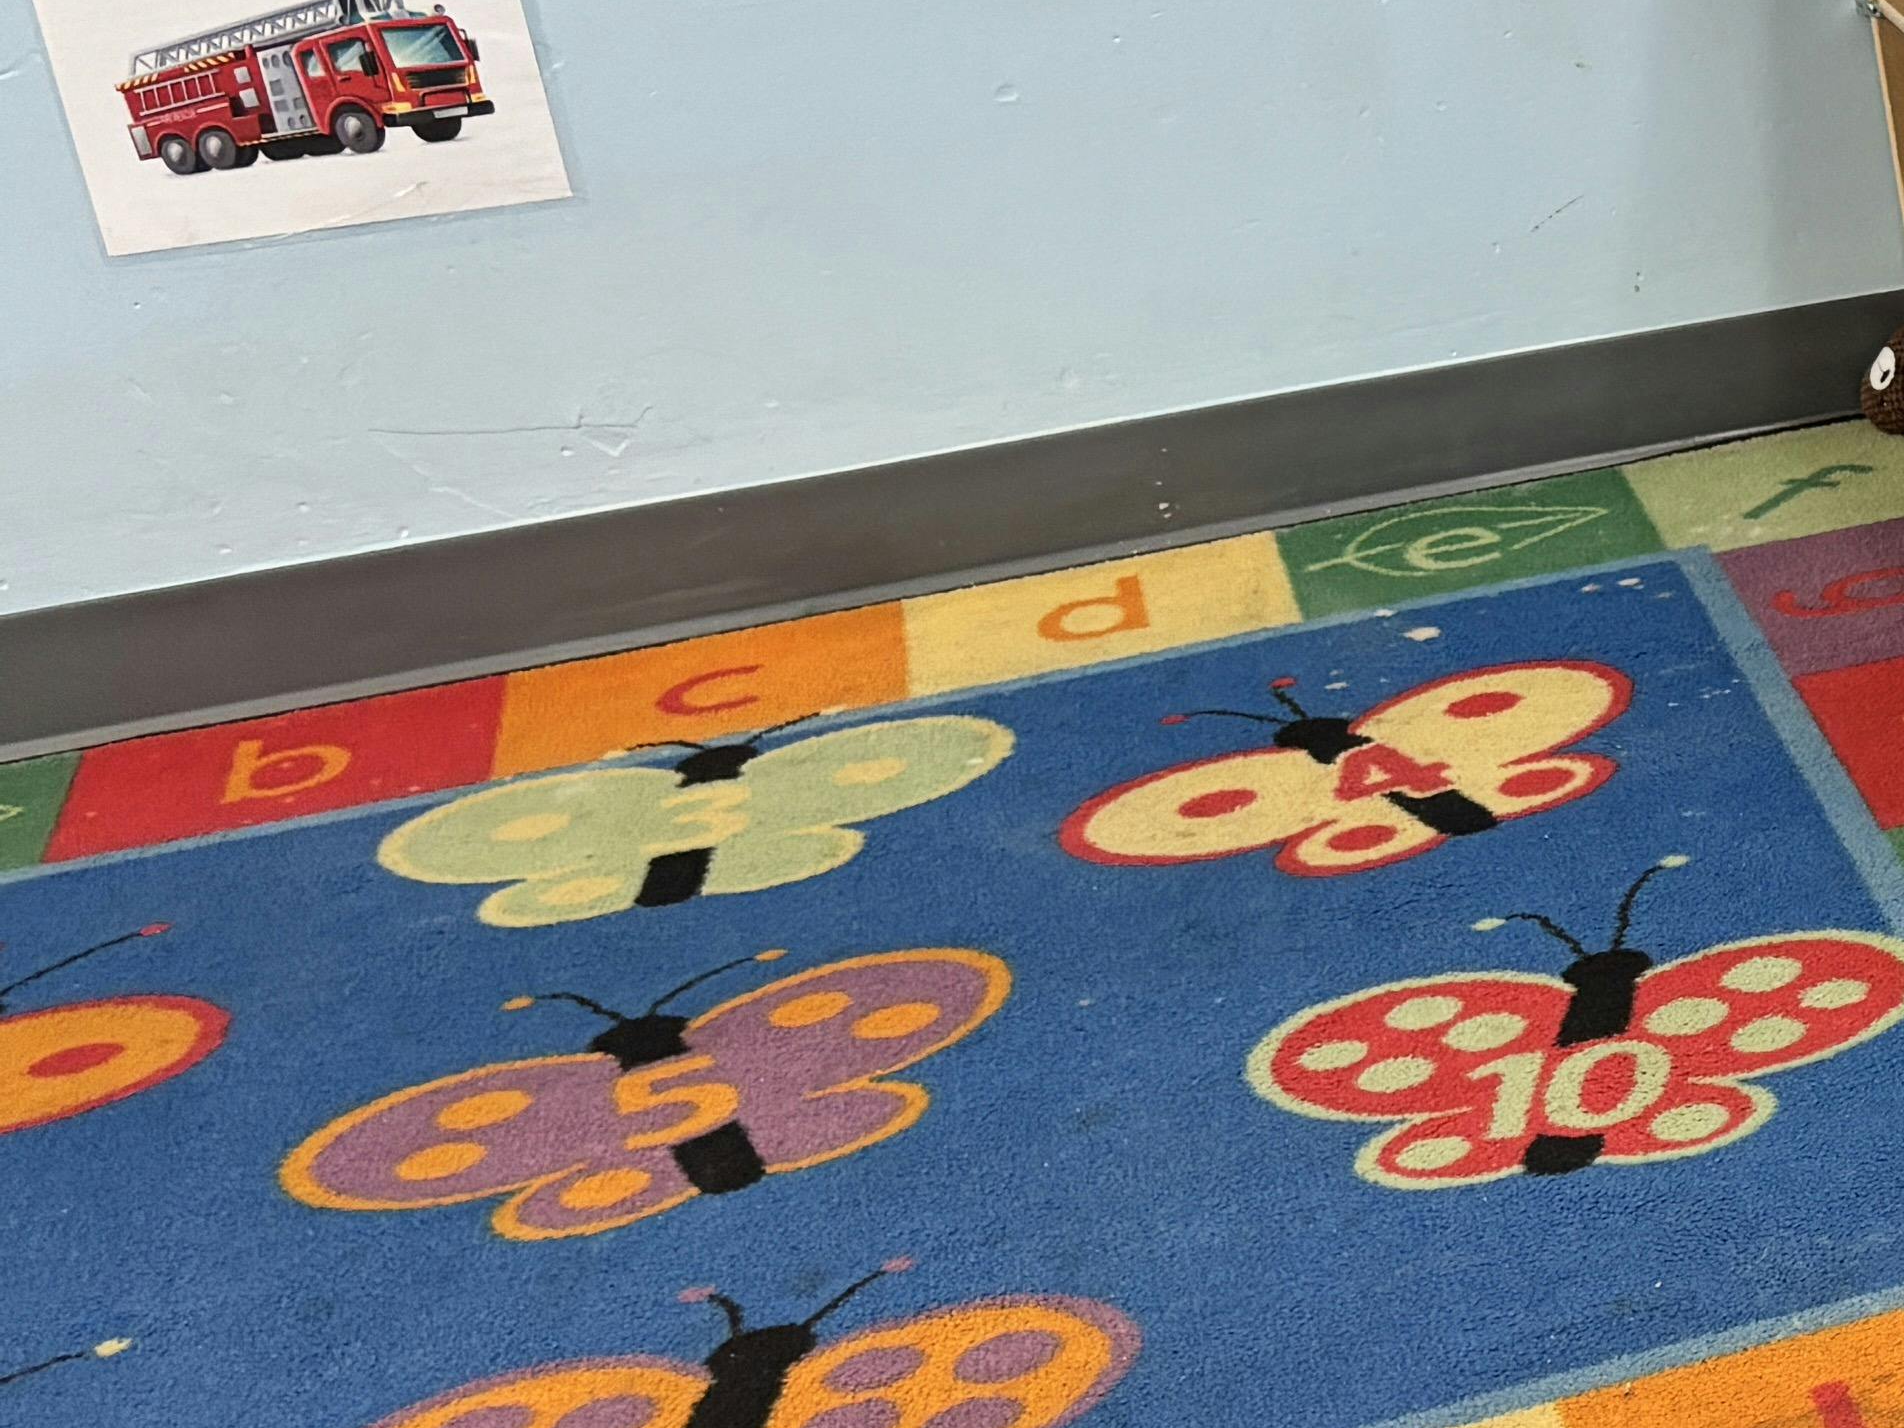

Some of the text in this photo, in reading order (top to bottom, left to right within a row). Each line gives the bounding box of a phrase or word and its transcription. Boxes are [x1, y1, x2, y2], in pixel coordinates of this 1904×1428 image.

[1742, 463, 1874, 520] f
[1036, 575, 1154, 642] d
[654, 663, 761, 718] c
[219, 738, 353, 804] b
[1333, 743, 1460, 803] 4
[659, 785, 751, 848] 3
[613, 1053, 740, 1152] 5
[1477, 1038, 1675, 1140] 10
